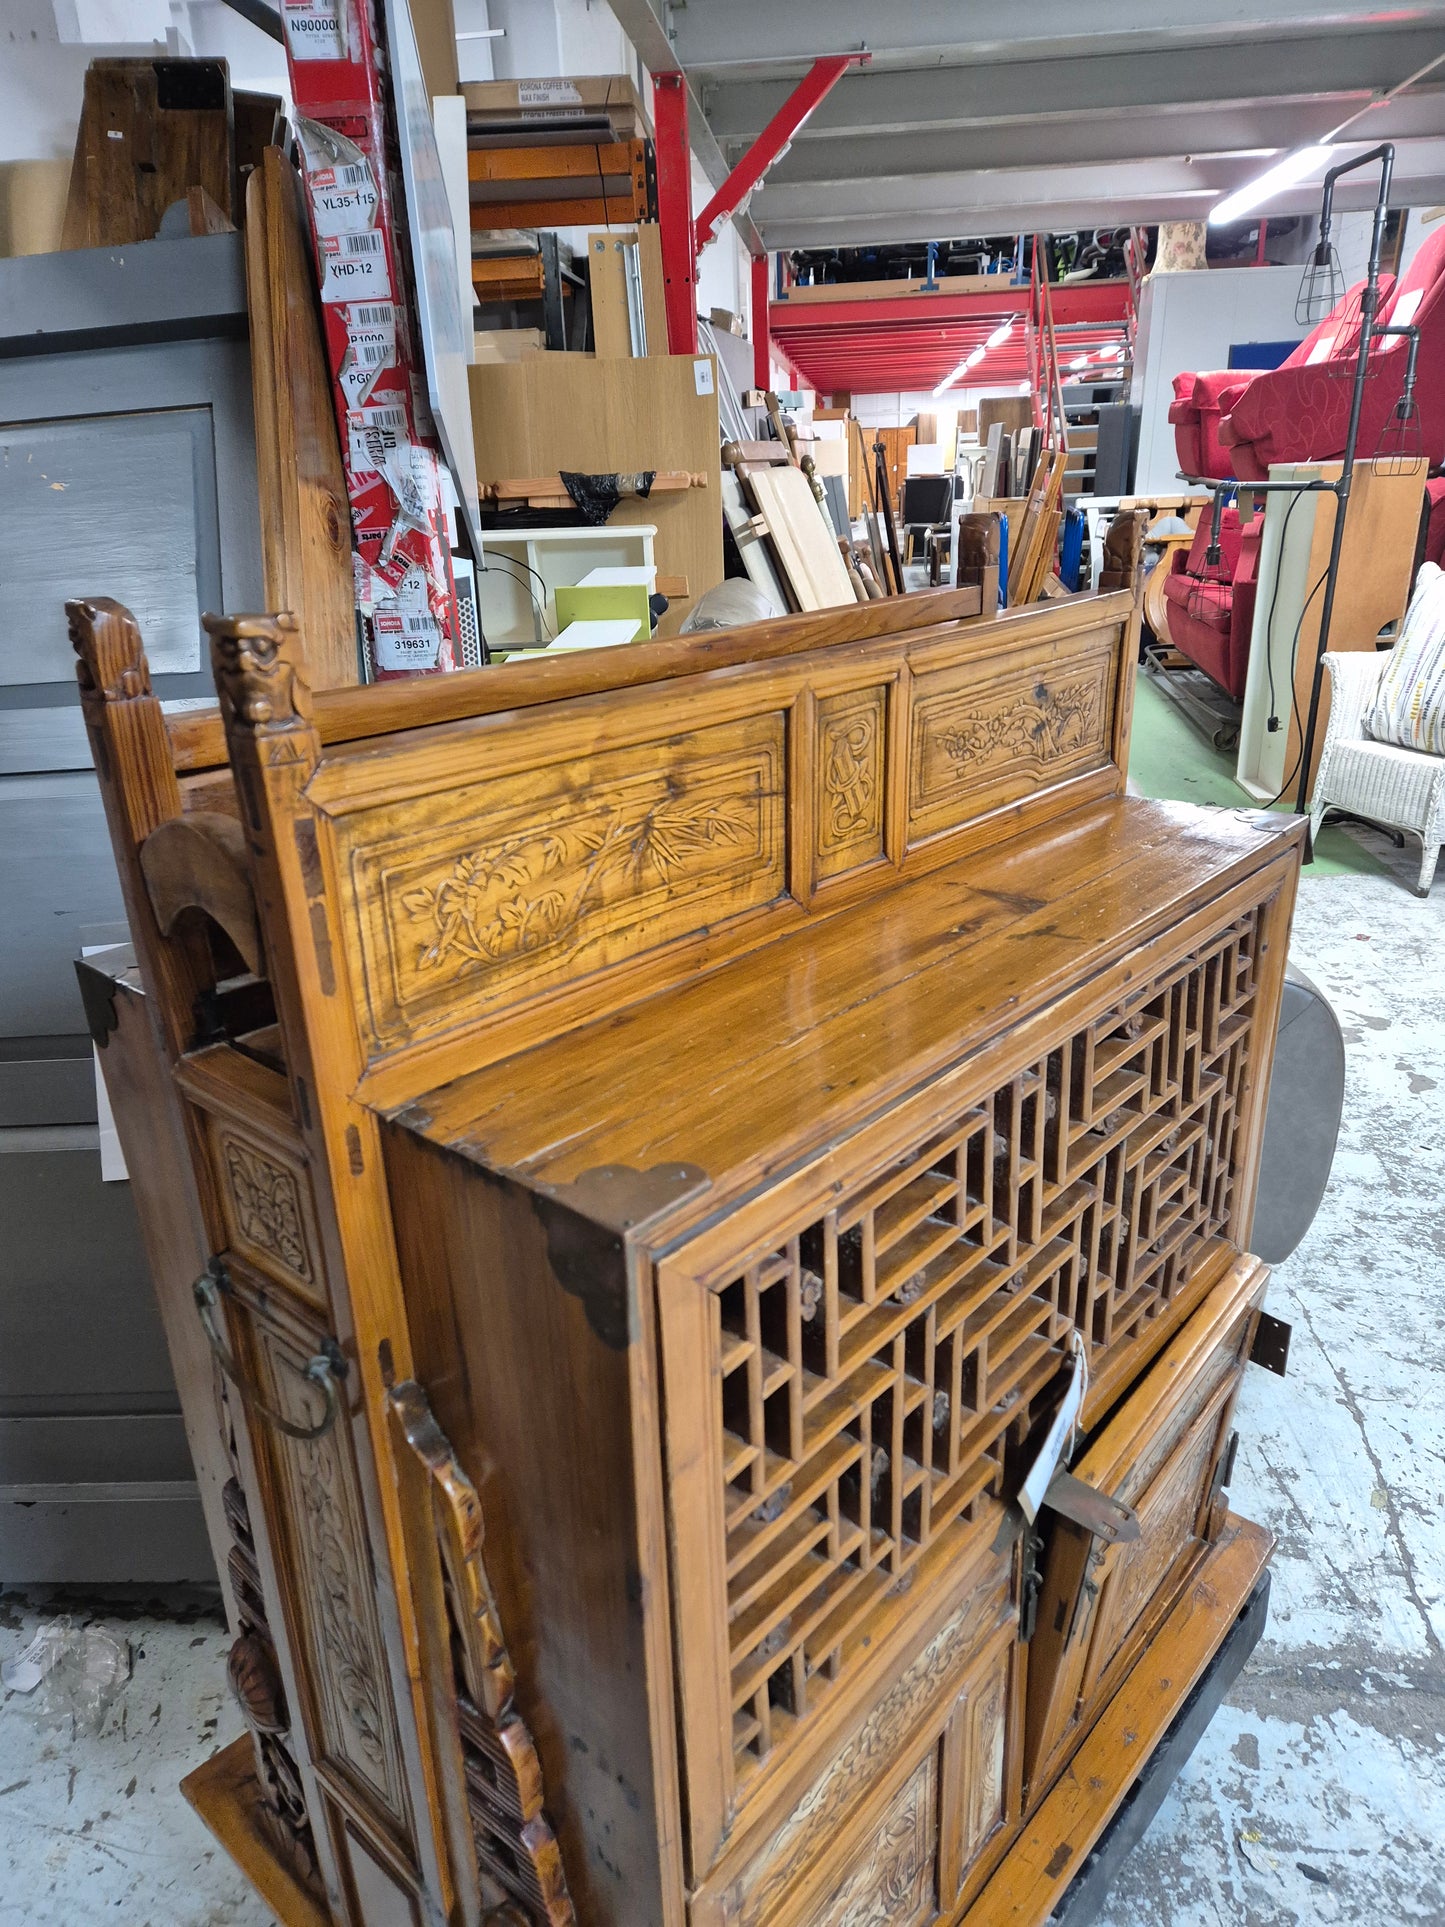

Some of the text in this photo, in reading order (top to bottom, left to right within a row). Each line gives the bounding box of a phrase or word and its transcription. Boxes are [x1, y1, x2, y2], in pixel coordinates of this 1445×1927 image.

[322, 192, 375, 210] YL35-115
[330, 262, 372, 278] YHD-12
[361, 532, 382, 541] parts
[394, 639, 431, 650] 319631
